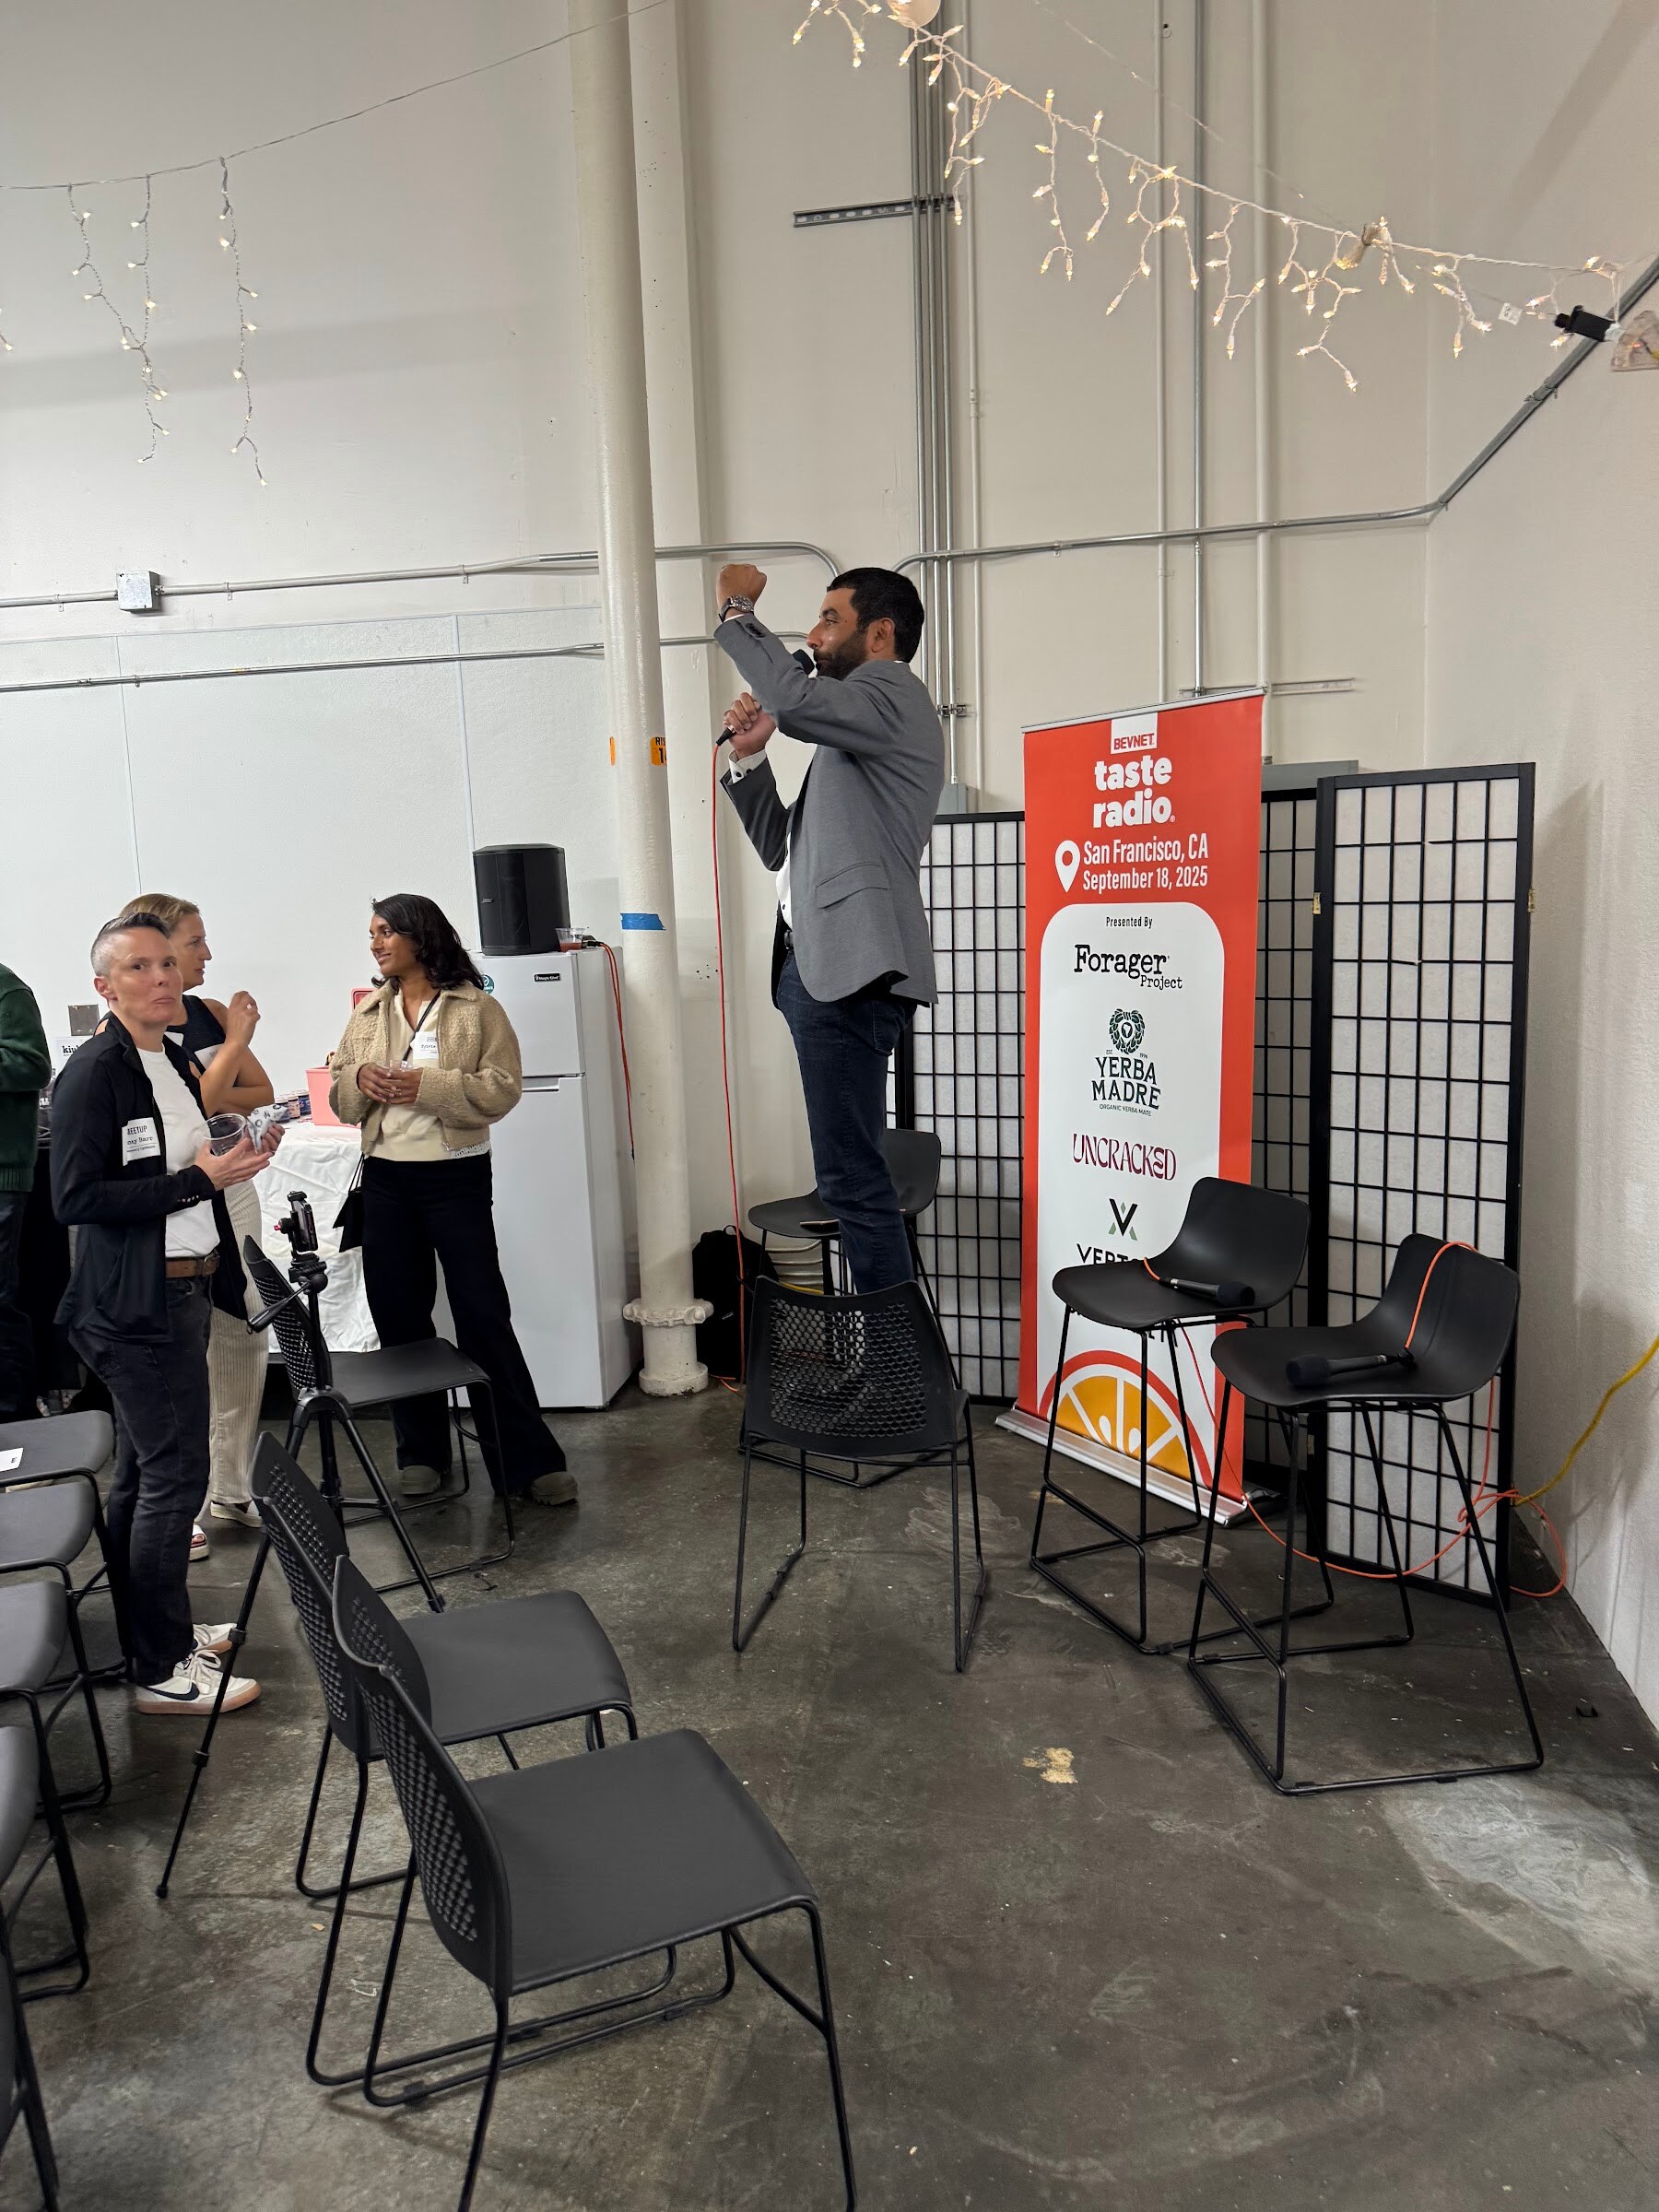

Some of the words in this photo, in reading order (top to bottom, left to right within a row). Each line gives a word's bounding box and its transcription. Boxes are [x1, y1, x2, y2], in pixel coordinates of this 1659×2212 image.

[1114, 733, 1155, 750] BEVNET
[1095, 755, 1172, 791] taste
[1083, 840, 1110, 865] San
[1113, 835, 1185, 864] Francisco,
[1188, 832, 1208, 860] CA
[1083, 867, 1154, 895] September
[1156, 867, 1172, 890] 18,
[1175, 865, 1208, 888] 2025
[1106, 916, 1142, 927] Presented
[1144, 916, 1153, 929] By
[1074, 944, 1168, 980] Forager
[1140, 975, 1182, 991] Project
[1095, 1057, 1157, 1085] YERBA
[1091, 1079, 1160, 1110] MADRE
[1073, 1133, 1177, 1181] UNCRACKED
[1077, 1243, 1138, 1265] VERT
